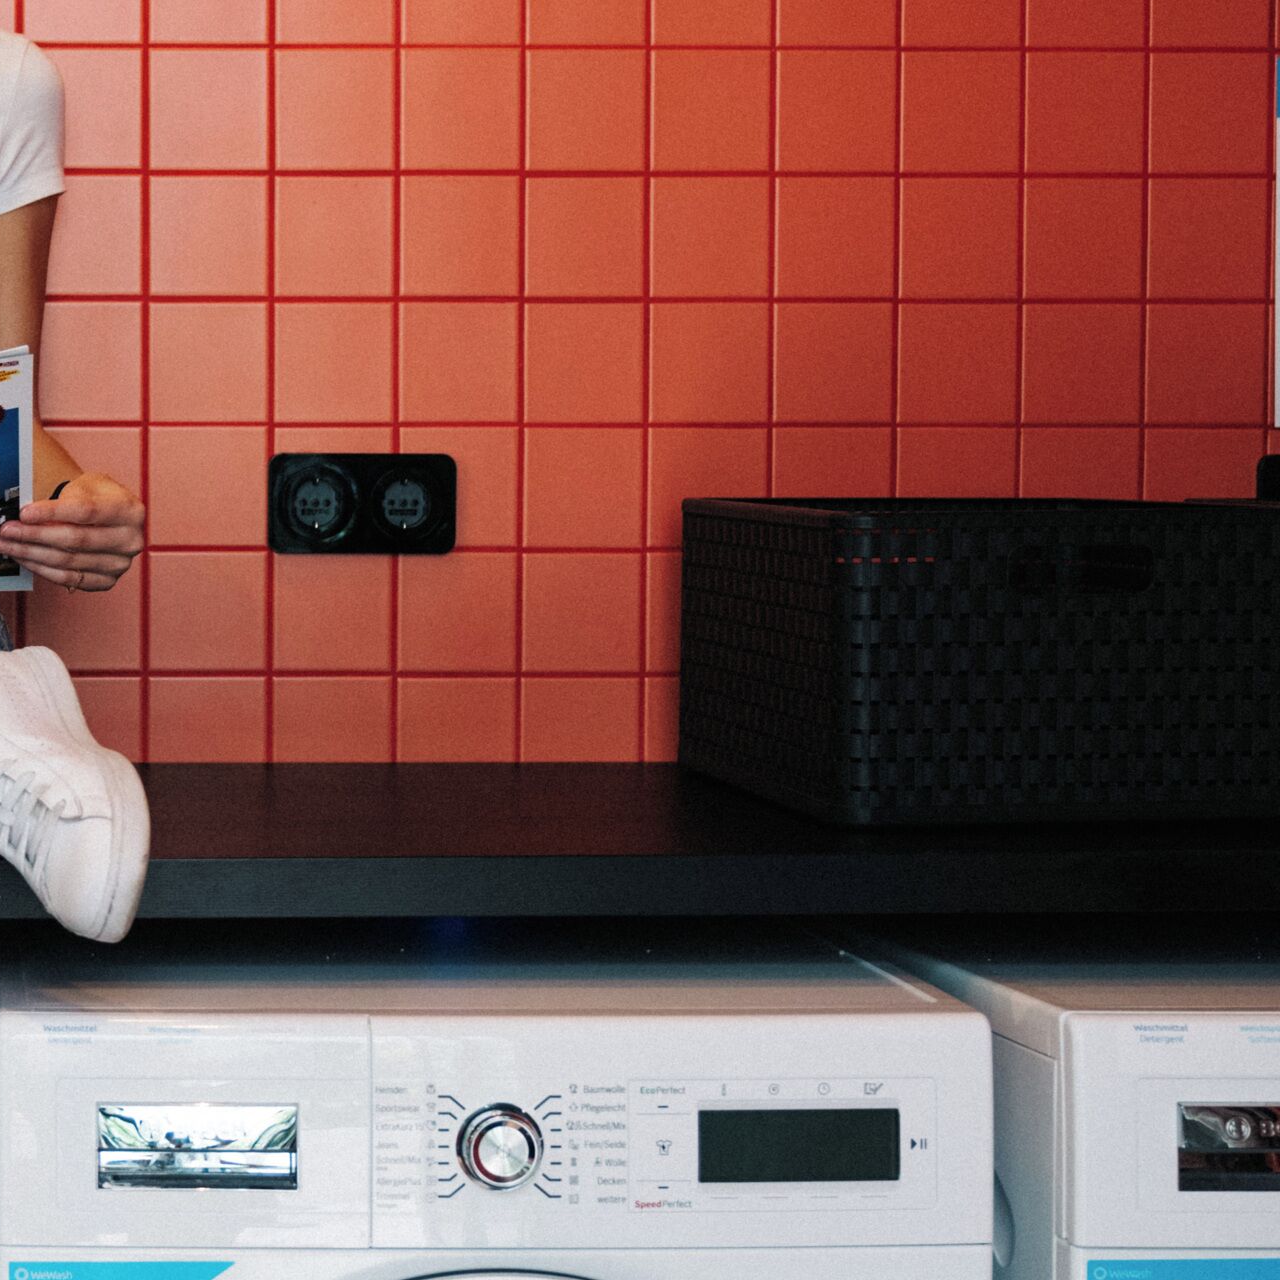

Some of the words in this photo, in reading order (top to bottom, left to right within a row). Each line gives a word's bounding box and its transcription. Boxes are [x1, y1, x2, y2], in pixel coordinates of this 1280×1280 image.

[640, 1086, 686, 1095] EcoPerfect
[634, 1199, 692, 1210] SpeedPerfect
[31, 1270, 73, 1280] WeWash
